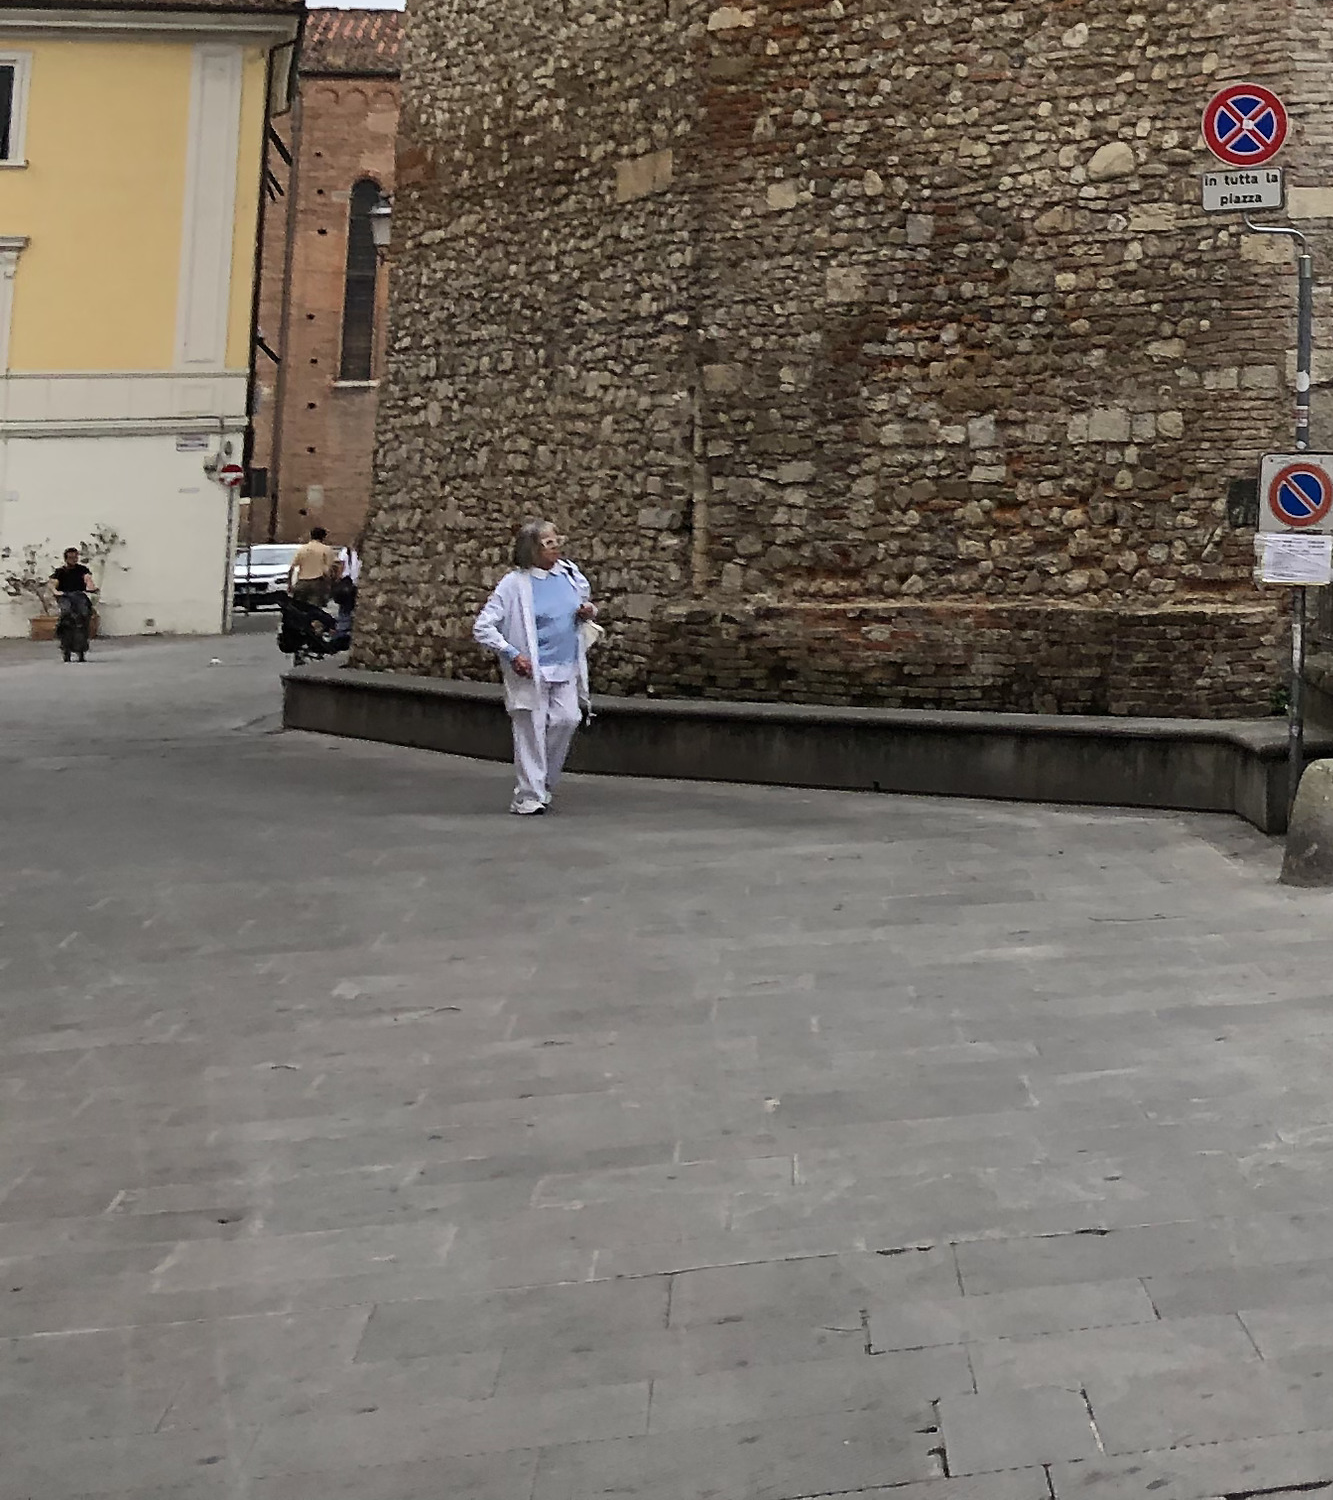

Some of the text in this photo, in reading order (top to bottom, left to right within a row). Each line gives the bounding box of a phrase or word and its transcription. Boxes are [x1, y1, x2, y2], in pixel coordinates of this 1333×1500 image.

[1205, 172, 1278, 186] in tutta la
[1220, 193, 1262, 206] piazza
